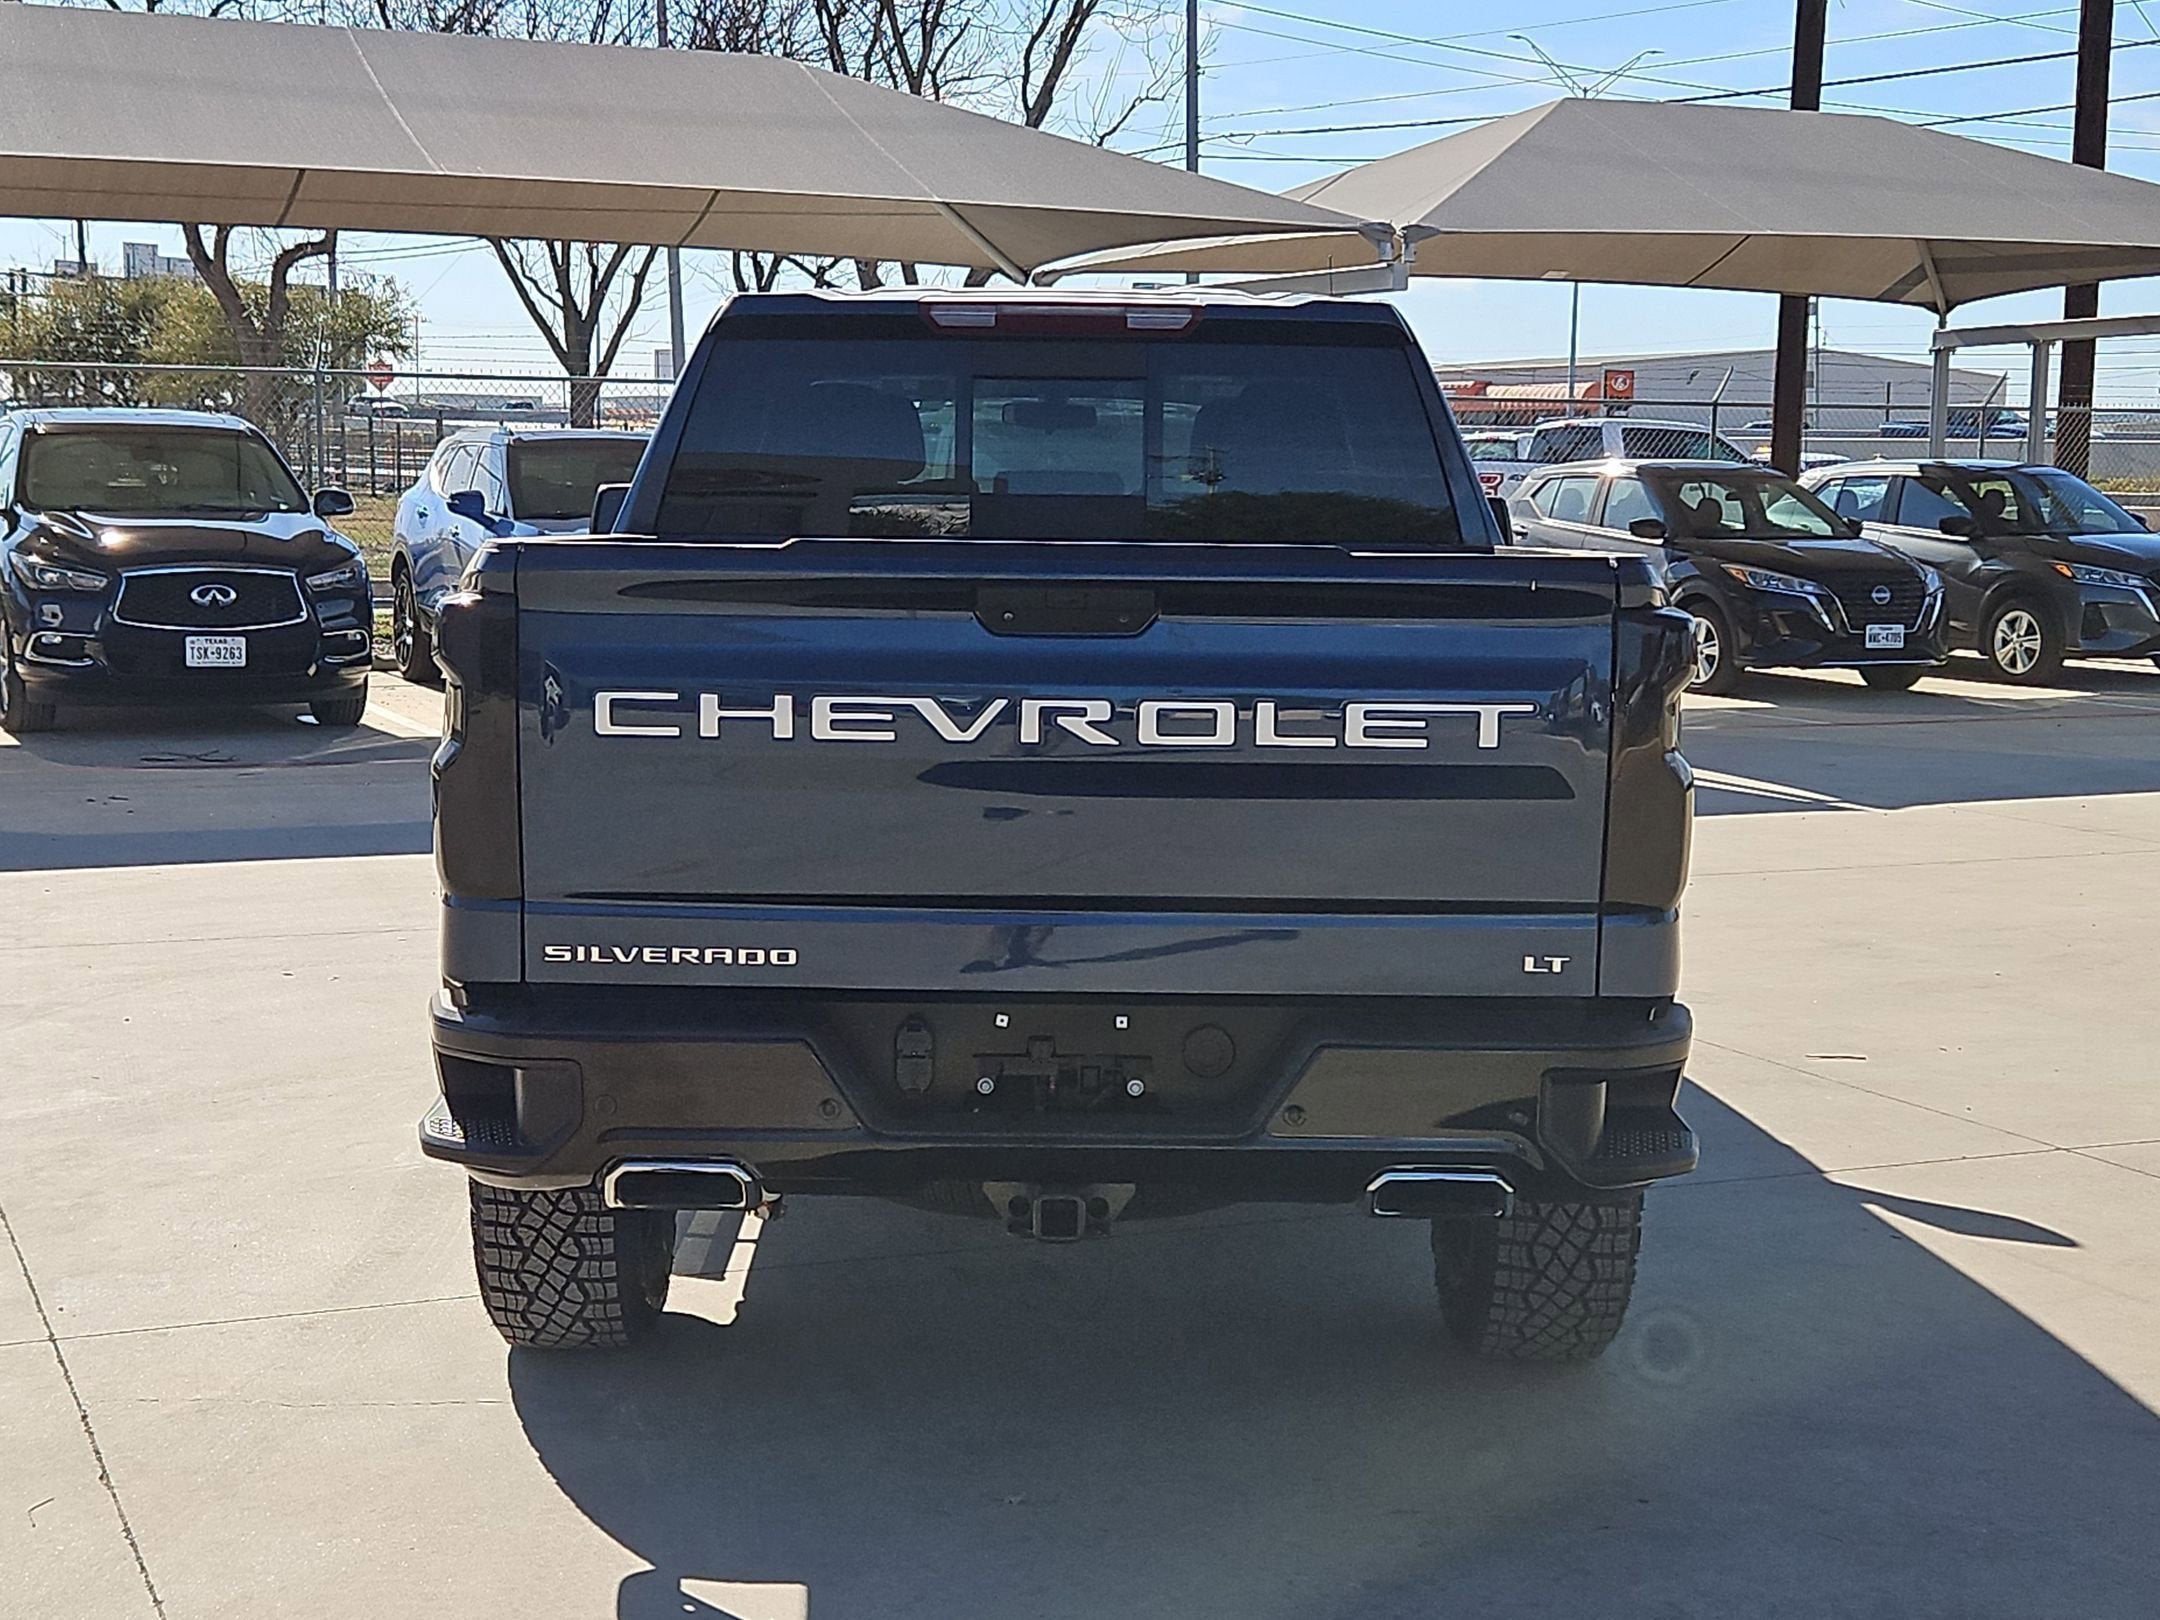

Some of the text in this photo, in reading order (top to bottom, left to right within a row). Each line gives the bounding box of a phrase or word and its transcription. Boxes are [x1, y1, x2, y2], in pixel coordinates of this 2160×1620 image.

[594, 691, 1535, 749] CHEVROLET
[543, 945, 798, 966] SILVERADO
[1523, 955, 1571, 973] LT
